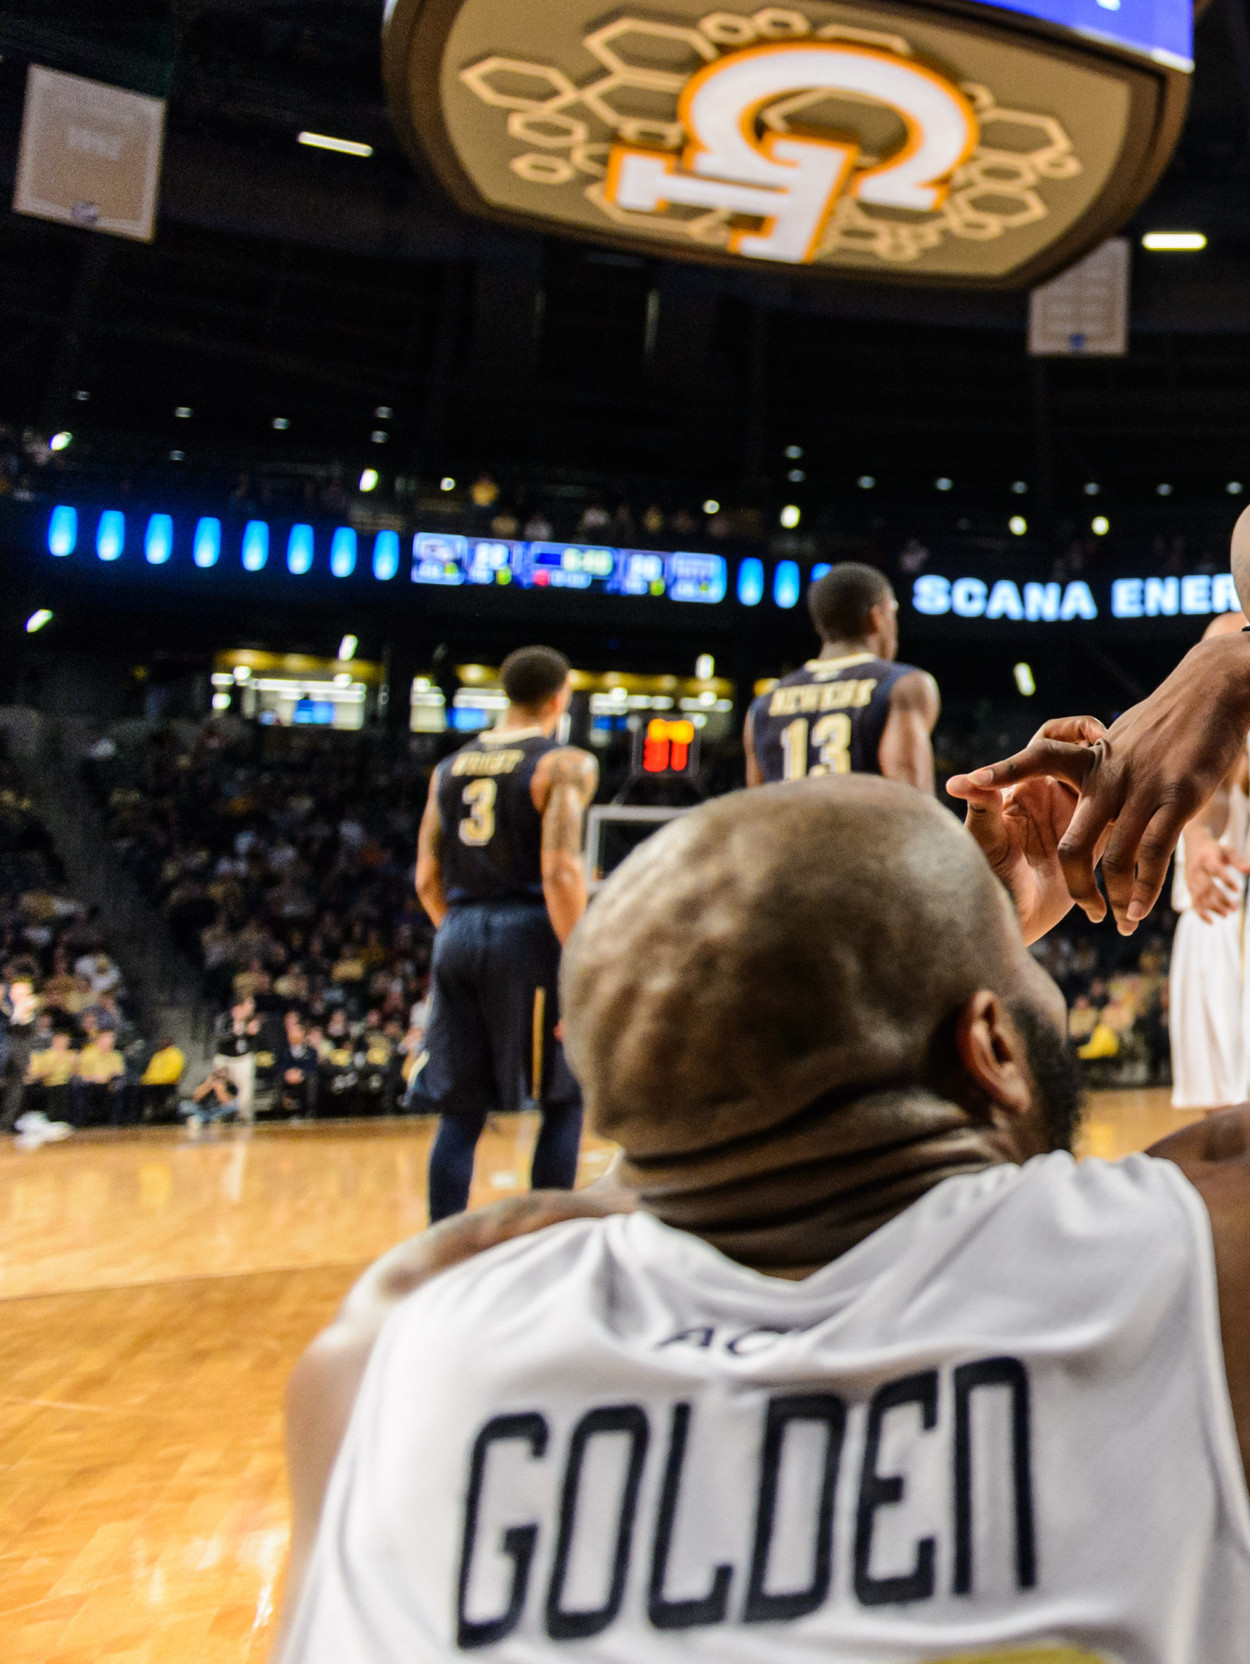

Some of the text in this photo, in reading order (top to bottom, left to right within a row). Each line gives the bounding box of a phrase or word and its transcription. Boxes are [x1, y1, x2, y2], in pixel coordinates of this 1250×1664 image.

[912, 574, 1098, 621] SCANA
[1111, 573, 1242, 618] ENER
[781, 712, 851, 782] 13
[458, 777, 497, 846] 3
[456, 1356, 1037, 1652] GOLDEN
